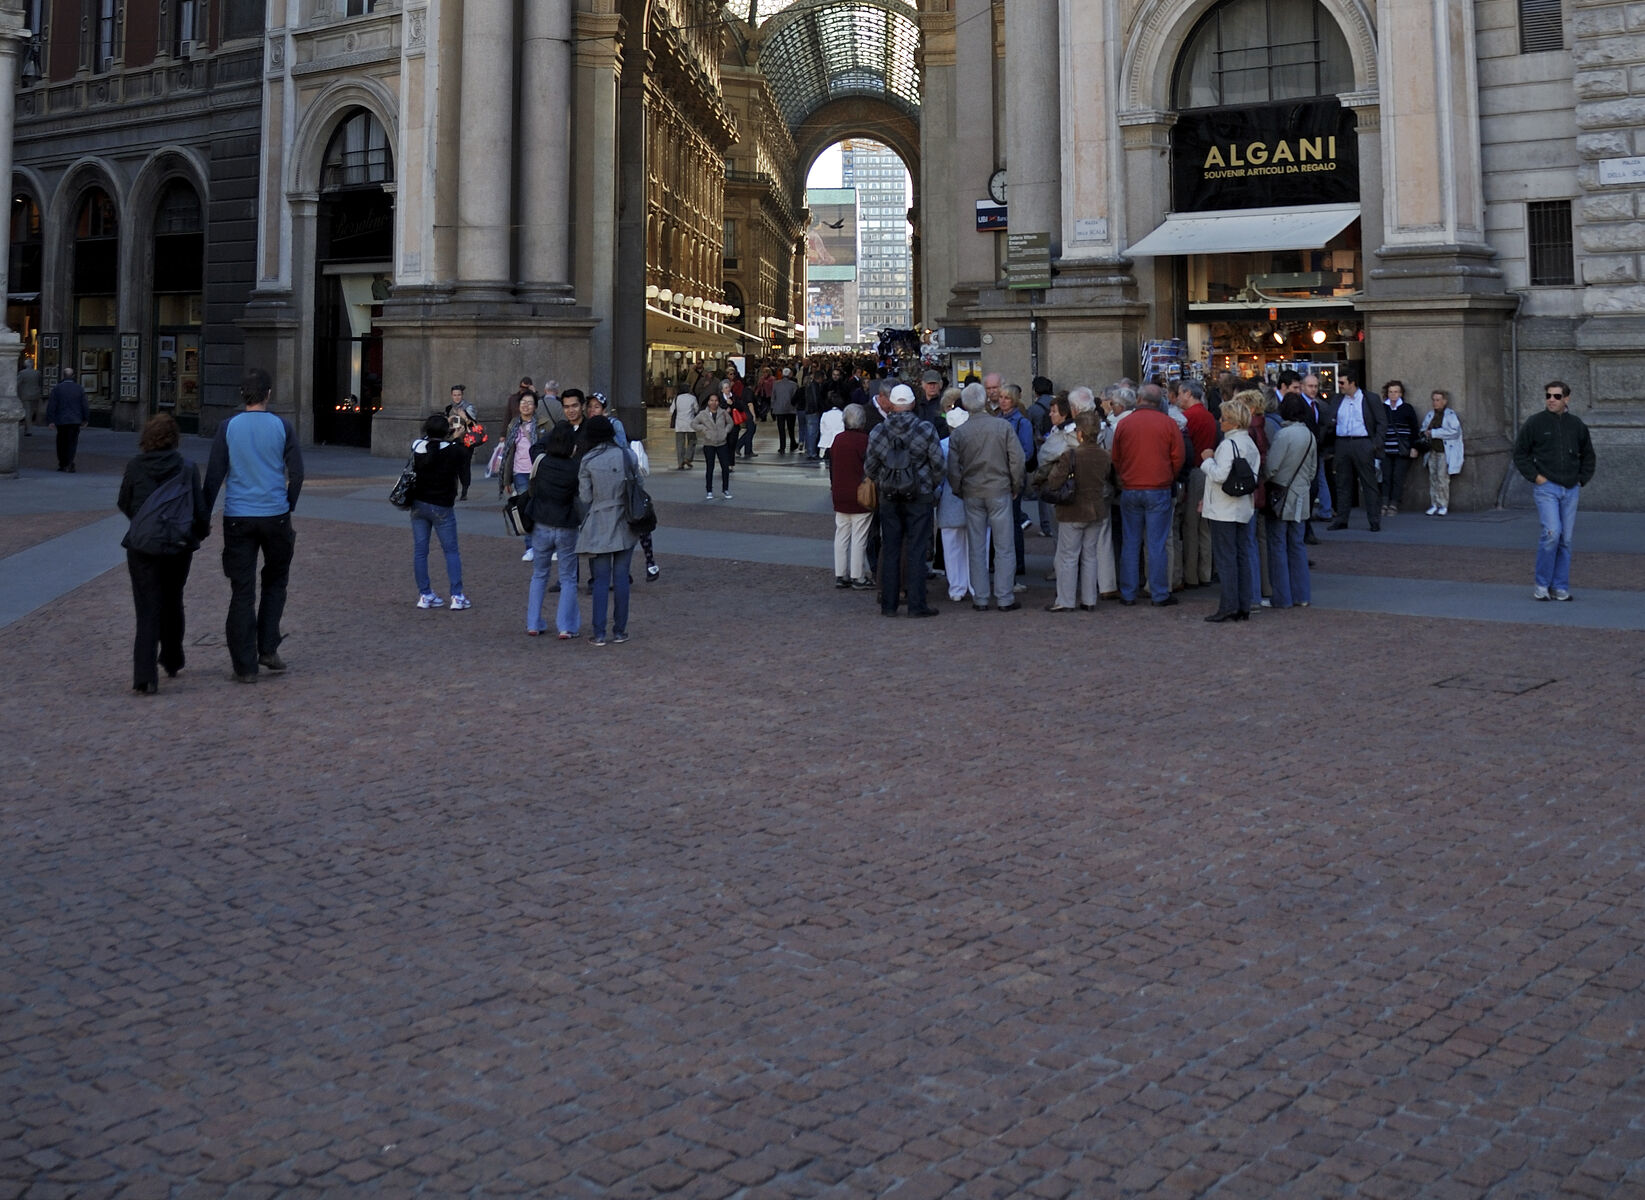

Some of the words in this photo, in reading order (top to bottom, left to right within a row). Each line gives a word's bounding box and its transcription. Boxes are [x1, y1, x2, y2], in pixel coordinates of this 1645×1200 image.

[1204, 136, 1336, 168] ALGANI
[1204, 169, 1245, 179] SOUVENIR
[1247, 166, 1284, 176] ARTICOLI
[1286, 165, 1299, 173] DA
[1301, 162, 1336, 172] REGALO
[811, 345, 852, 353] NOVECENTO
